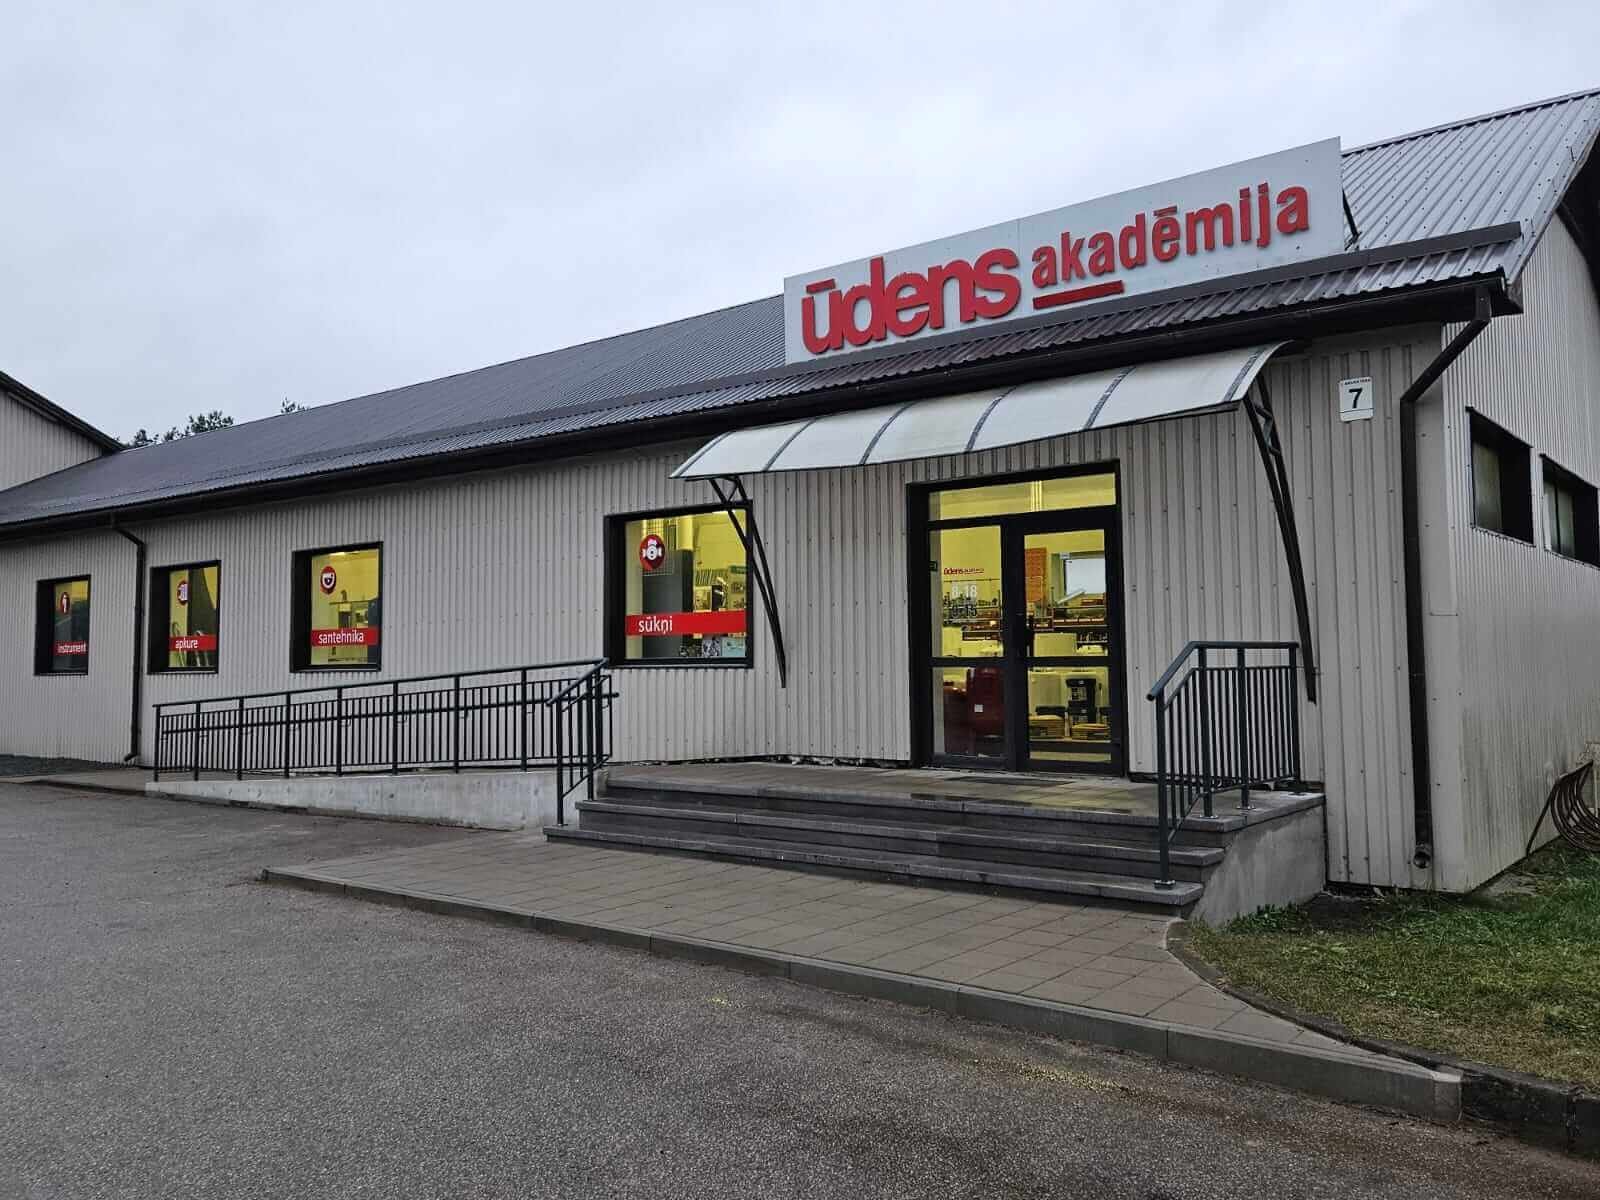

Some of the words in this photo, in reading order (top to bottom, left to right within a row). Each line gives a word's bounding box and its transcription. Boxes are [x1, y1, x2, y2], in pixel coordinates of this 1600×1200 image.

[801, 249, 1021, 354] ūdens
[1031, 182, 1309, 288] akadēmija
[1349, 387, 1363, 409] 7
[638, 615, 673, 635] sūkņi
[175, 637, 198, 653] apkure
[318, 629, 364, 644] santehnika
